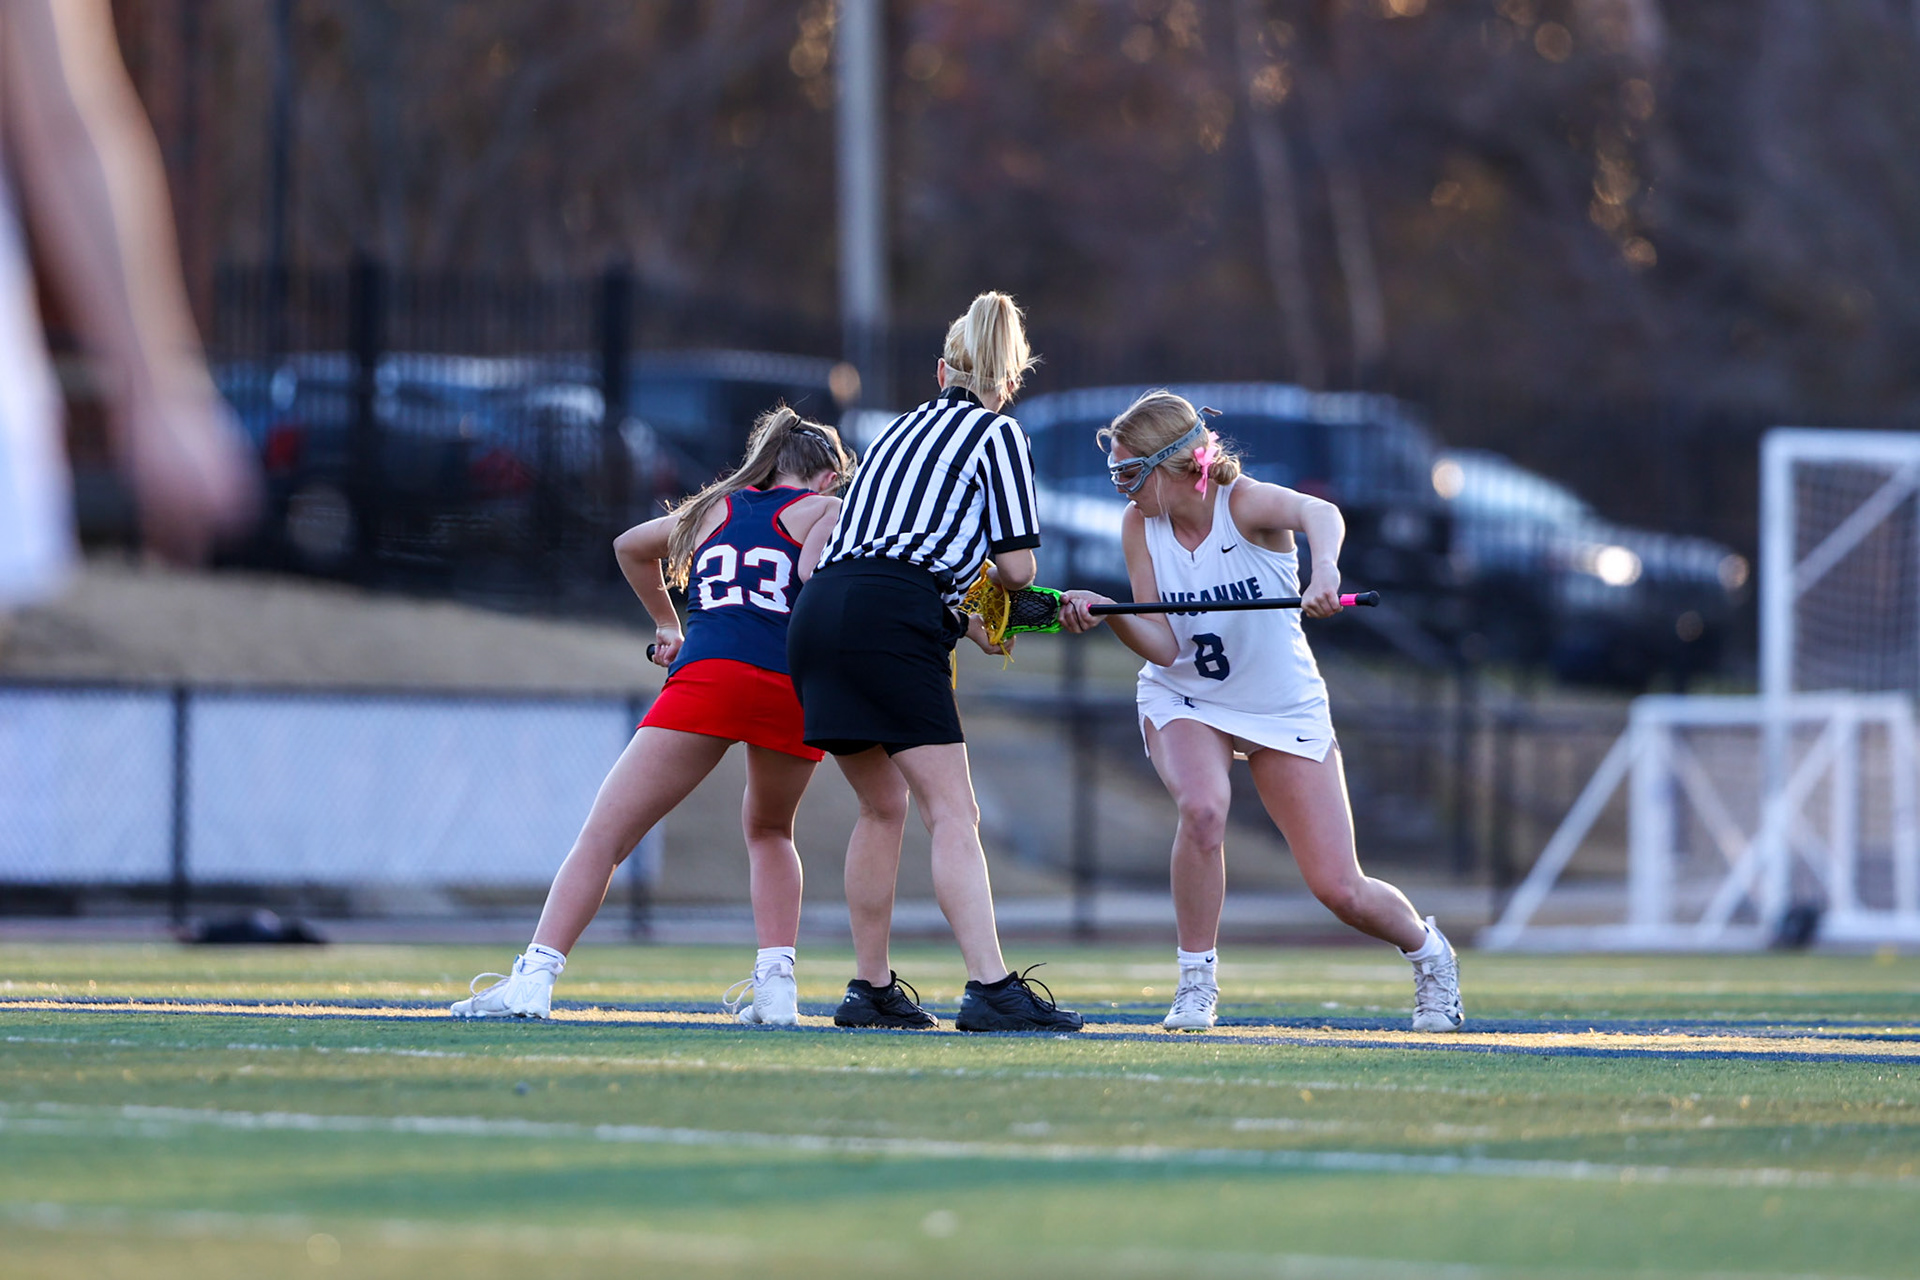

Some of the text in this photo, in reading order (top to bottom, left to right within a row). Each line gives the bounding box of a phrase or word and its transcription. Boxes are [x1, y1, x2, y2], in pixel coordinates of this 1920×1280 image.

[1157, 444, 1178, 461] STX
[696, 543, 793, 614] 23
[1192, 633, 1230, 681] 8
